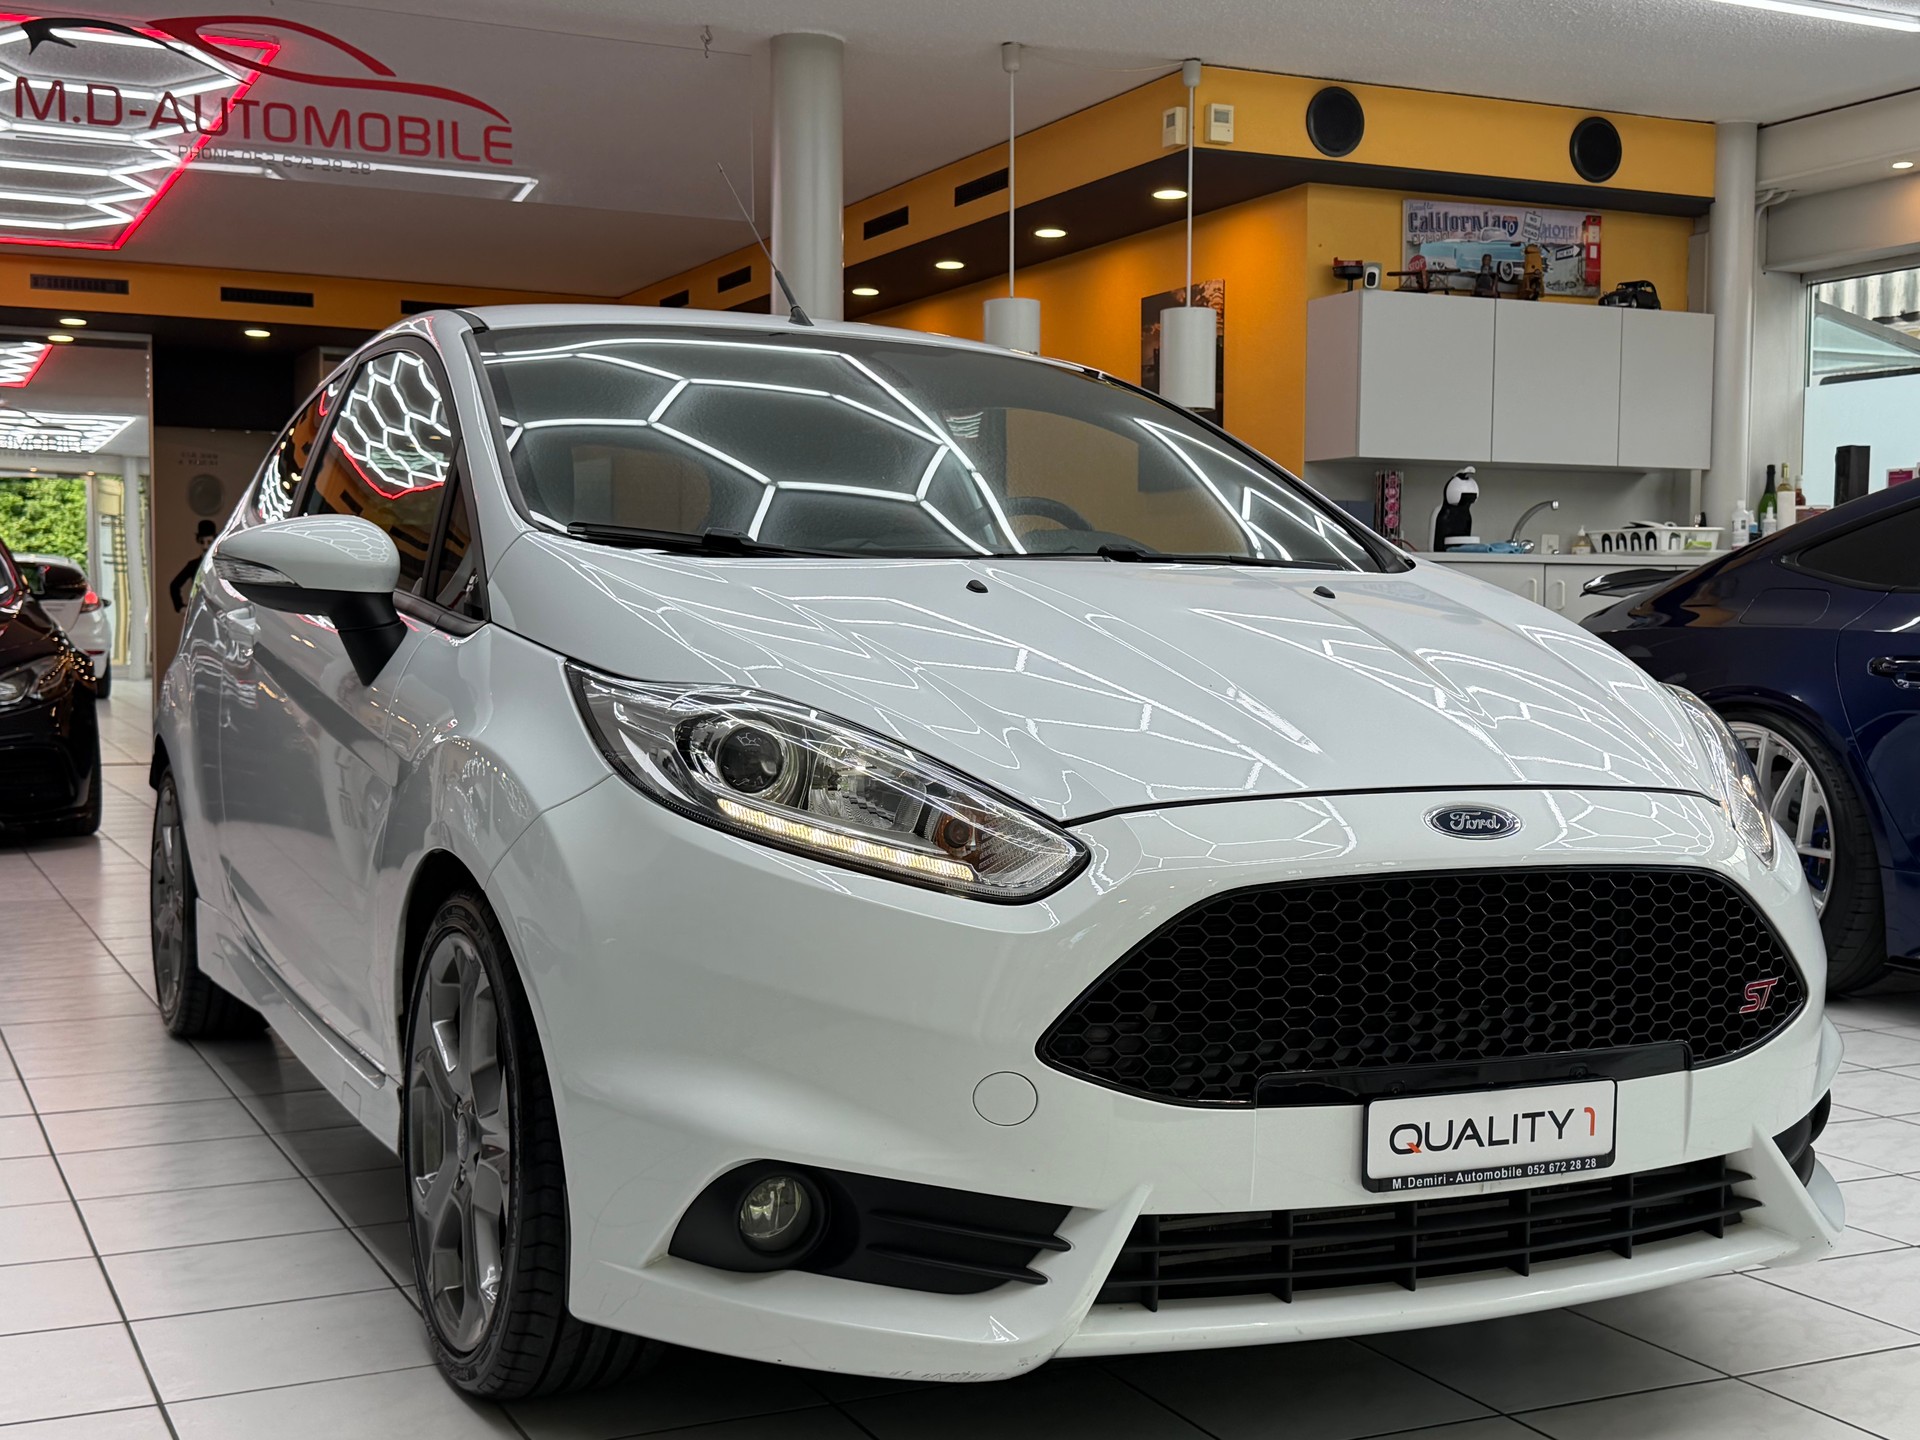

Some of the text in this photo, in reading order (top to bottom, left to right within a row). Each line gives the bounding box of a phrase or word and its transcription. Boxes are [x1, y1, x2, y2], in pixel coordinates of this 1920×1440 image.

[15, 77, 514, 166] M.D-AUTOMOBILE
[1407, 211, 1501, 233] California
[1505, 221, 1515, 233] 10
[1449, 811, 1501, 831] Ford
[1739, 977, 1779, 1014] ST
[1389, 1106, 1596, 1155] QUALITY 1
[1455, 1166, 1523, 1184] Automobile
[1527, 1164, 1546, 1176] 052
[1549, 1161, 1567, 1173] 672
[1569, 1159, 1582, 1171] 28
[1585, 1157, 1597, 1169] 28
